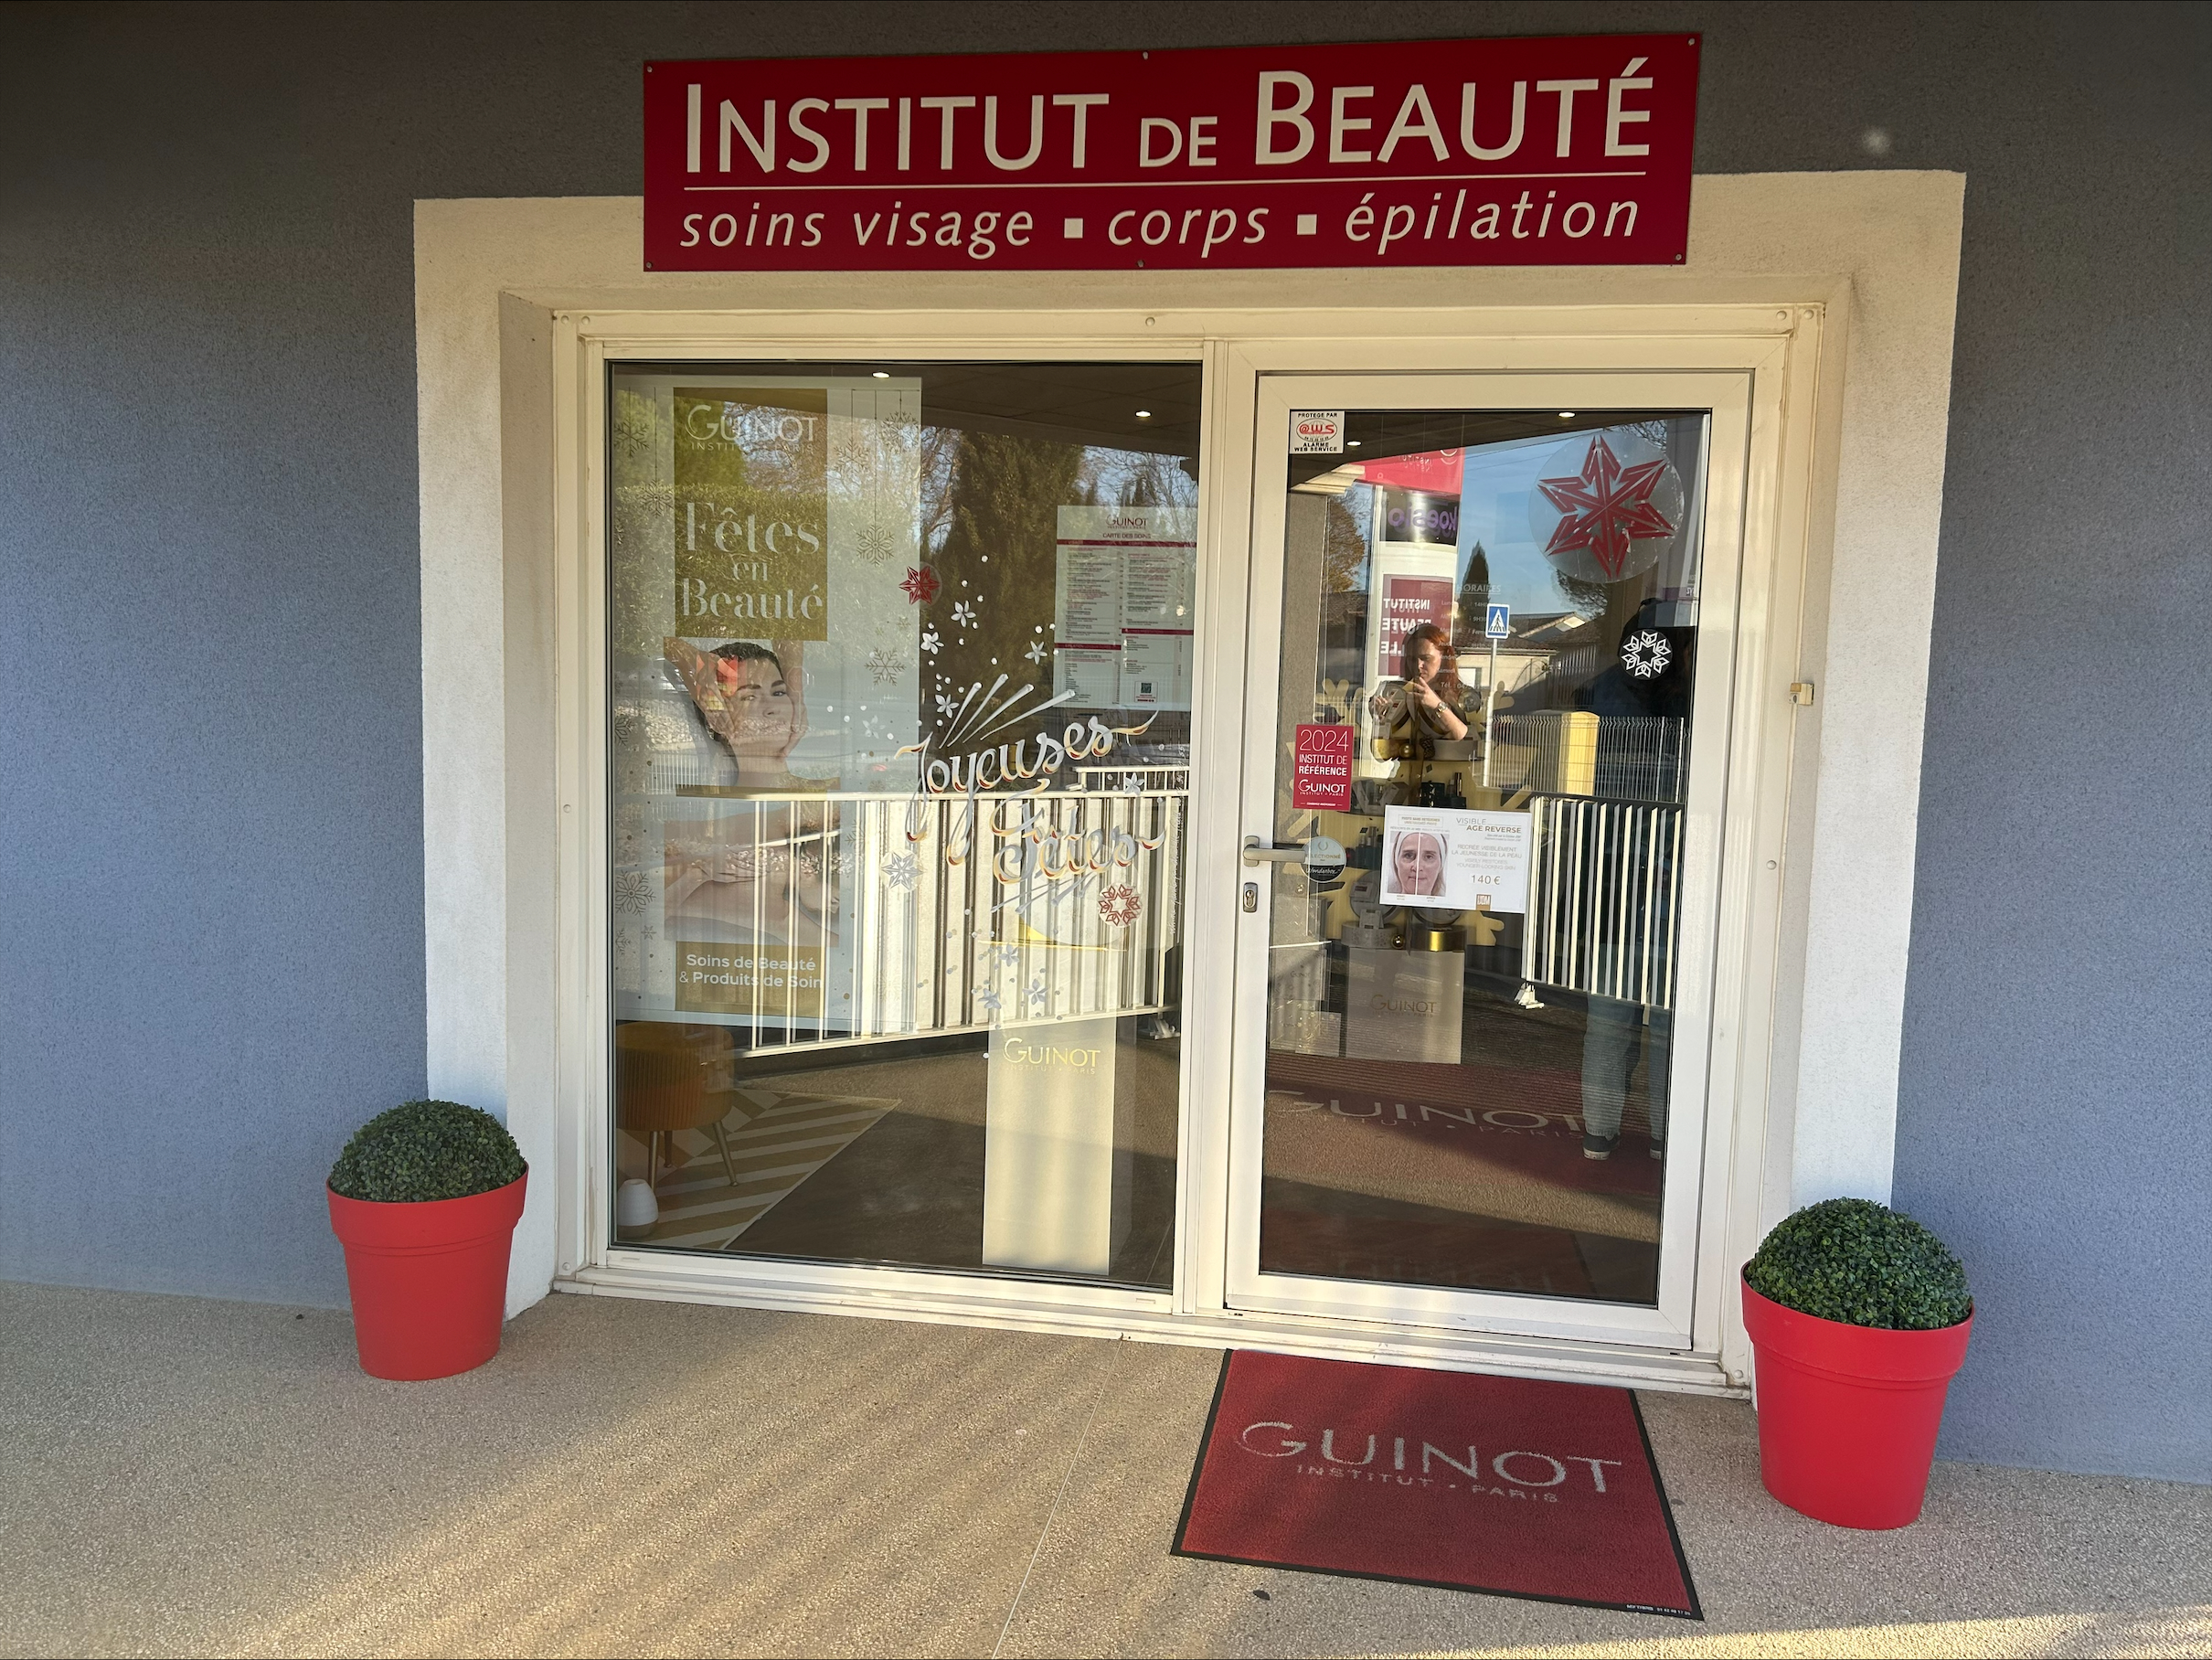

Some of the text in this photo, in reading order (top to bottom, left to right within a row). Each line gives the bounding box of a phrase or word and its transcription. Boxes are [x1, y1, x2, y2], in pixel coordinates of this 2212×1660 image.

[687, 57, 1654, 173] INSTITUT DE BEAUTÉ
[680, 188, 1638, 260] soins visage corps épilation
[686, 404, 819, 442] GUNOT
[692, 442, 752, 451] INSTIT
[686, 502, 820, 554] Fêtes
[1106, 514, 1148, 527] GUINOT
[733, 561, 768, 581] en
[682, 578, 823, 620] Beauté
[1299, 729, 1349, 751] 2024
[1299, 753, 1347, 765] INSTITUT DE
[1298, 764, 1347, 776] RÉFÉRENCE
[894, 710, 1159, 866] Joyeuses
[1298, 779, 1346, 793] GUINOT
[1484, 825, 1521, 834] REVERSE
[1472, 875, 1501, 885] 140 €
[686, 953, 816, 971] Soins de Beauté
[679, 971, 689, 984] &
[693, 972, 759, 986] Produits
[763, 974, 784, 987] de
[1370, 995, 1437, 1013] GUINOT
[1003, 1038, 1101, 1067] GUINOT
[1235, 1421, 1622, 1493] GUINOT
[1297, 1463, 1558, 1504] INSTITUT PARIS
